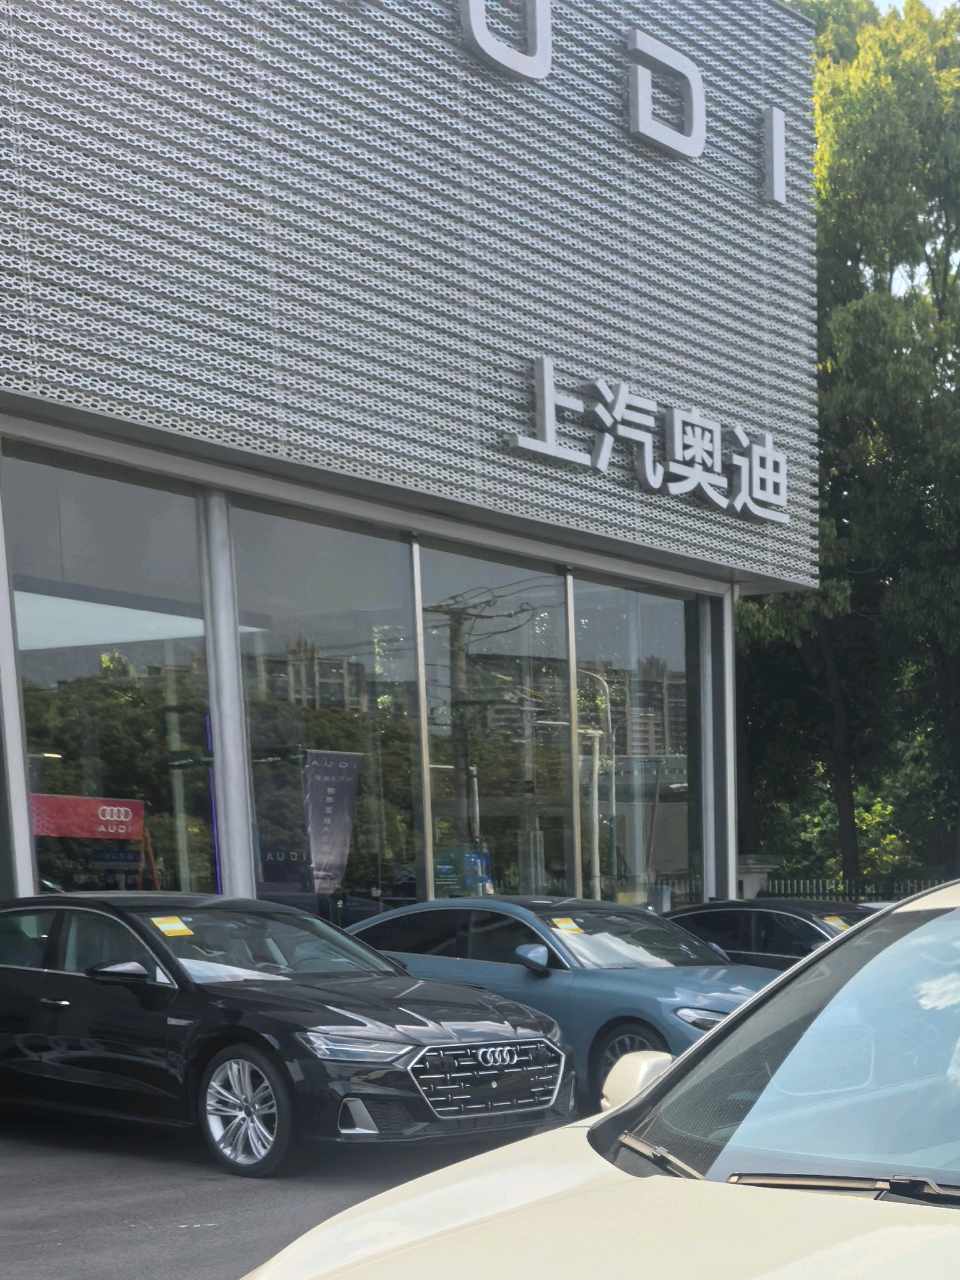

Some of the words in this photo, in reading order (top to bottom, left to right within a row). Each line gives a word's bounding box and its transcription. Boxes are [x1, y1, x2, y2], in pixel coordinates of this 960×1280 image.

[509, 355, 790, 524] 上汽奥迪
[97, 824, 132, 834] AUDI
